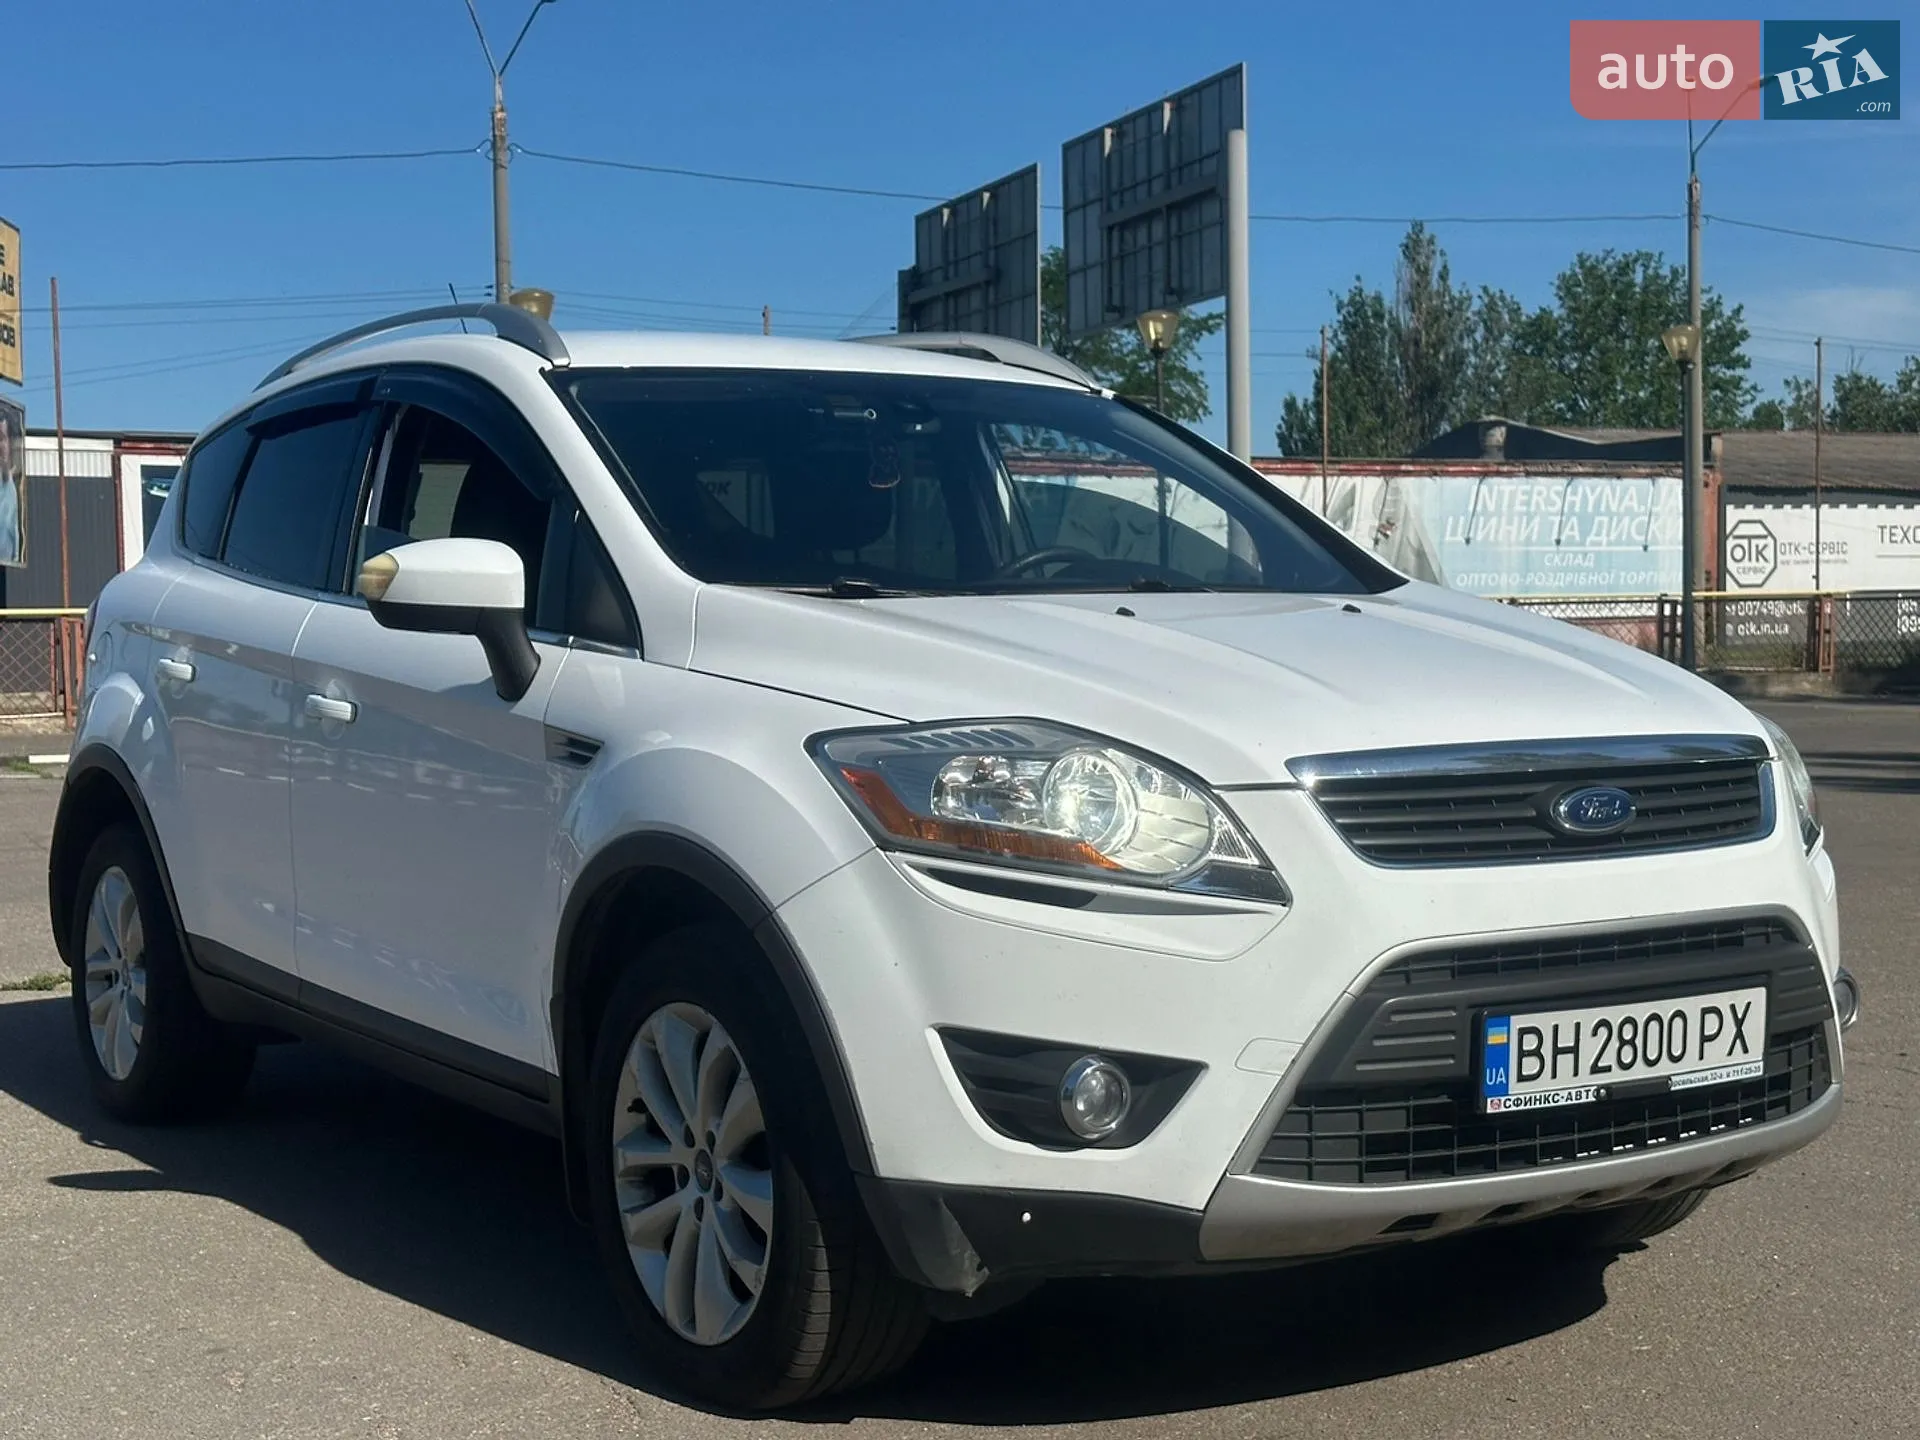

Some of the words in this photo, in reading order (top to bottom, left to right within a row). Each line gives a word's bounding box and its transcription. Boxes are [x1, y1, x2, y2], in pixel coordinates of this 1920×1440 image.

[1445, 515, 1540, 543] ШИНИ
[1547, 515, 1580, 543] ТА
[1543, 552, 1595, 567] СКЛАД
[1730, 534, 1769, 563] ОТК
[1580, 796, 1621, 821] Ford
[1486, 1066, 1507, 1086] UA
